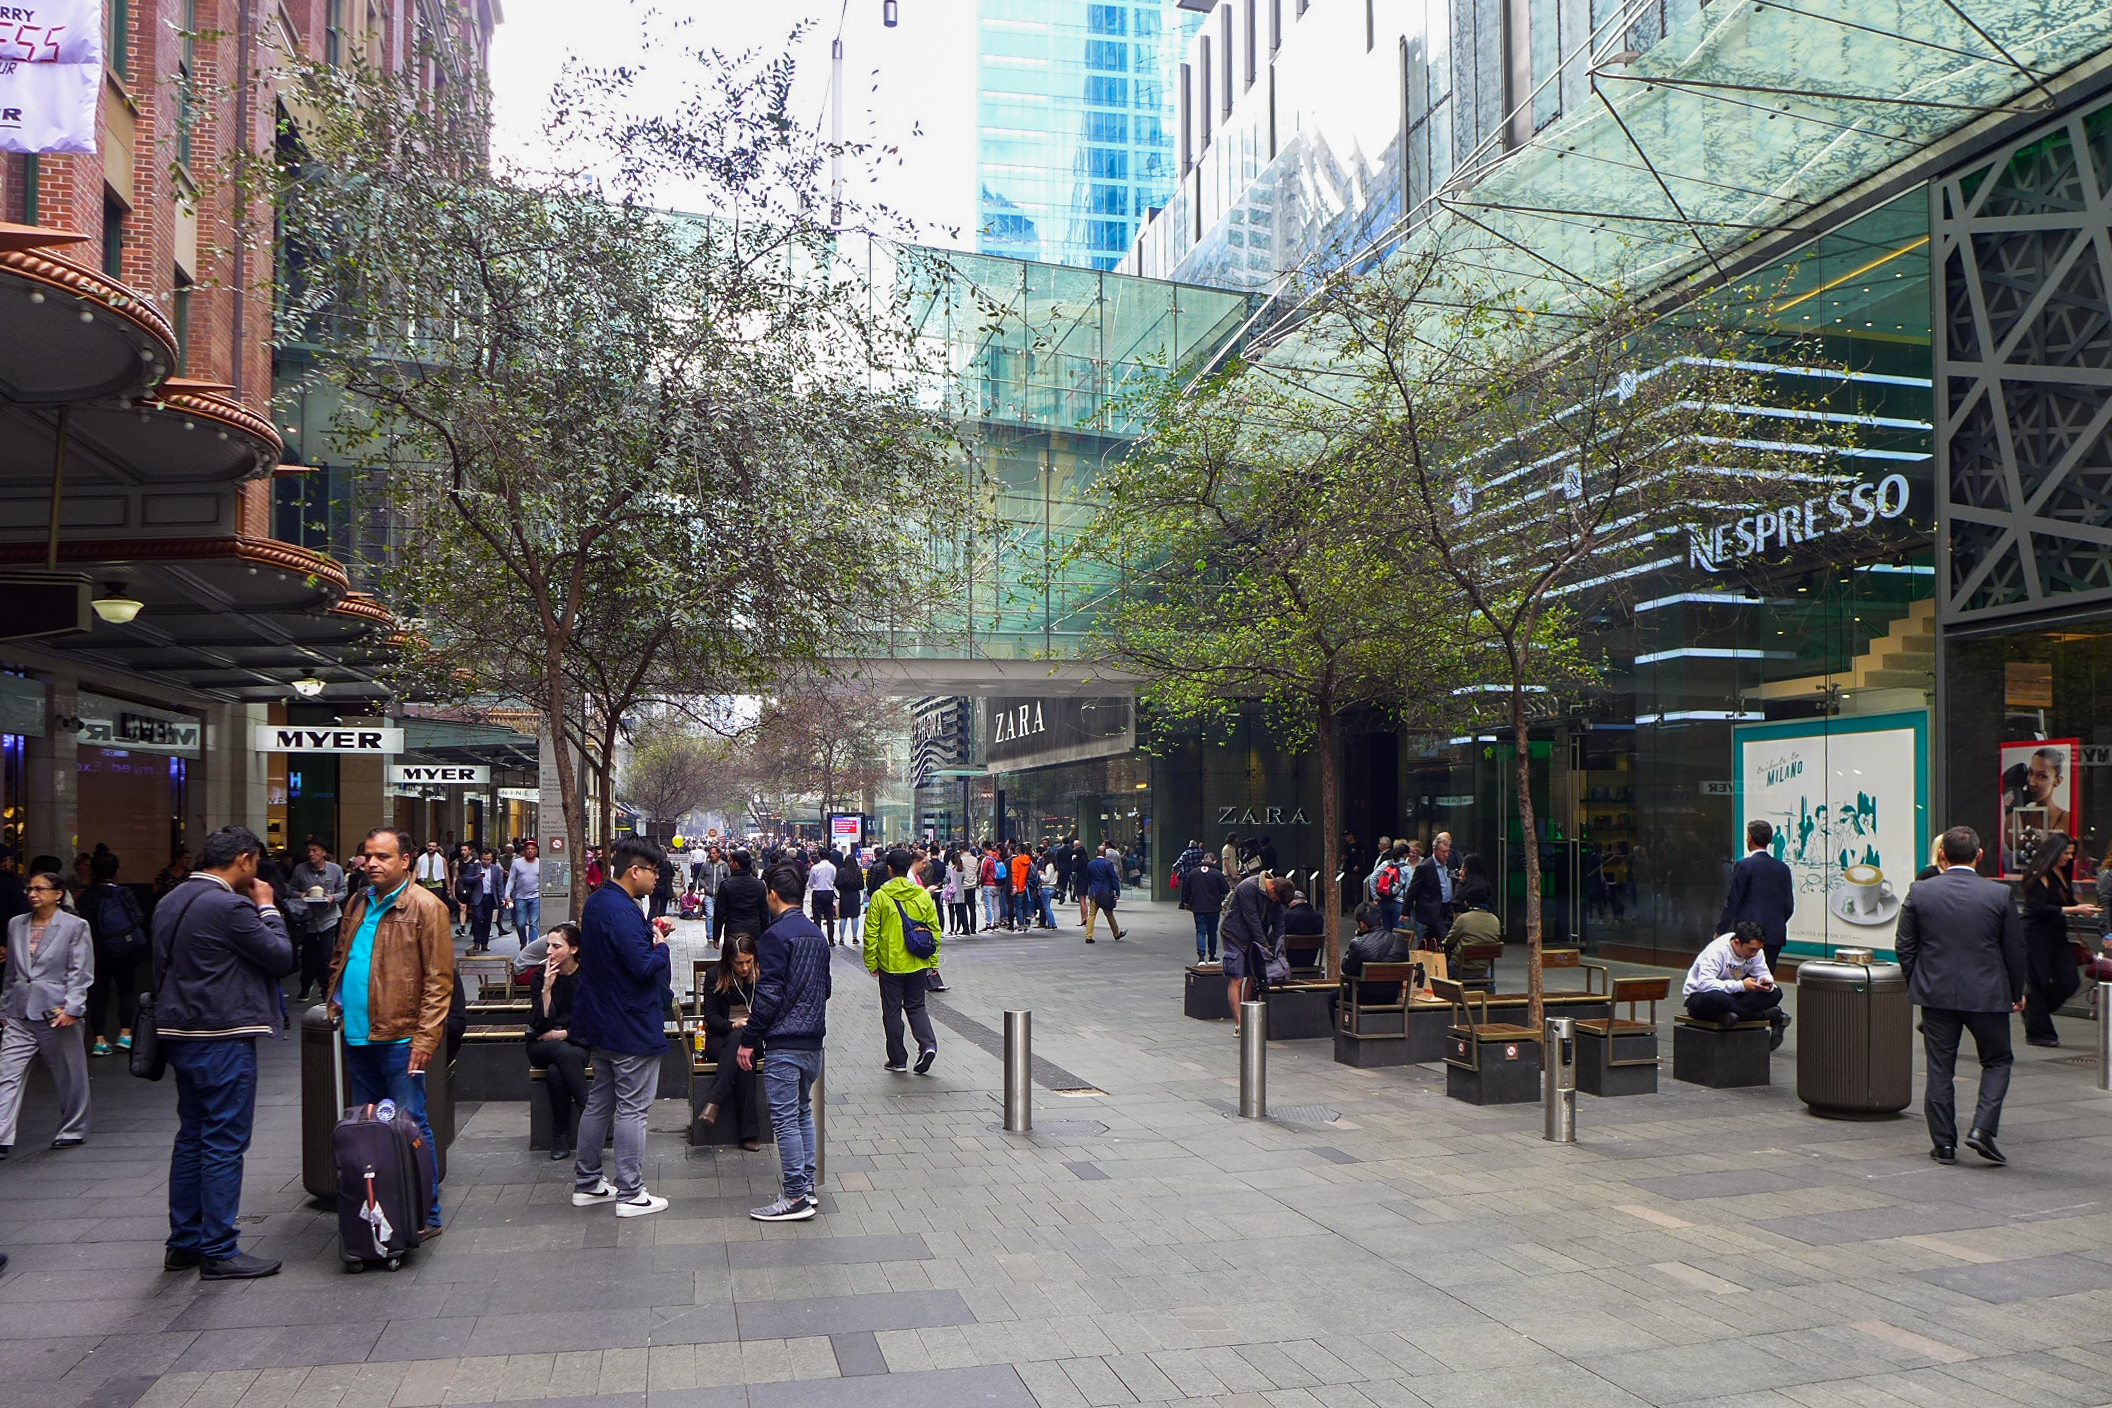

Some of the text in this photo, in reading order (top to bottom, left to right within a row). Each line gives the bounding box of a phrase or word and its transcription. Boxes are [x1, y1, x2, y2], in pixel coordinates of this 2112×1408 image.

[1684, 473, 1910, 573] NESPRESSO
[994, 700, 1046, 744] ZARA
[277, 730, 382, 749] MYER
[403, 768, 475, 780] MYER
[1766, 760, 1803, 787] MILANO
[501, 789, 528, 797] NINE
[1218, 806, 1312, 825] ZARA
